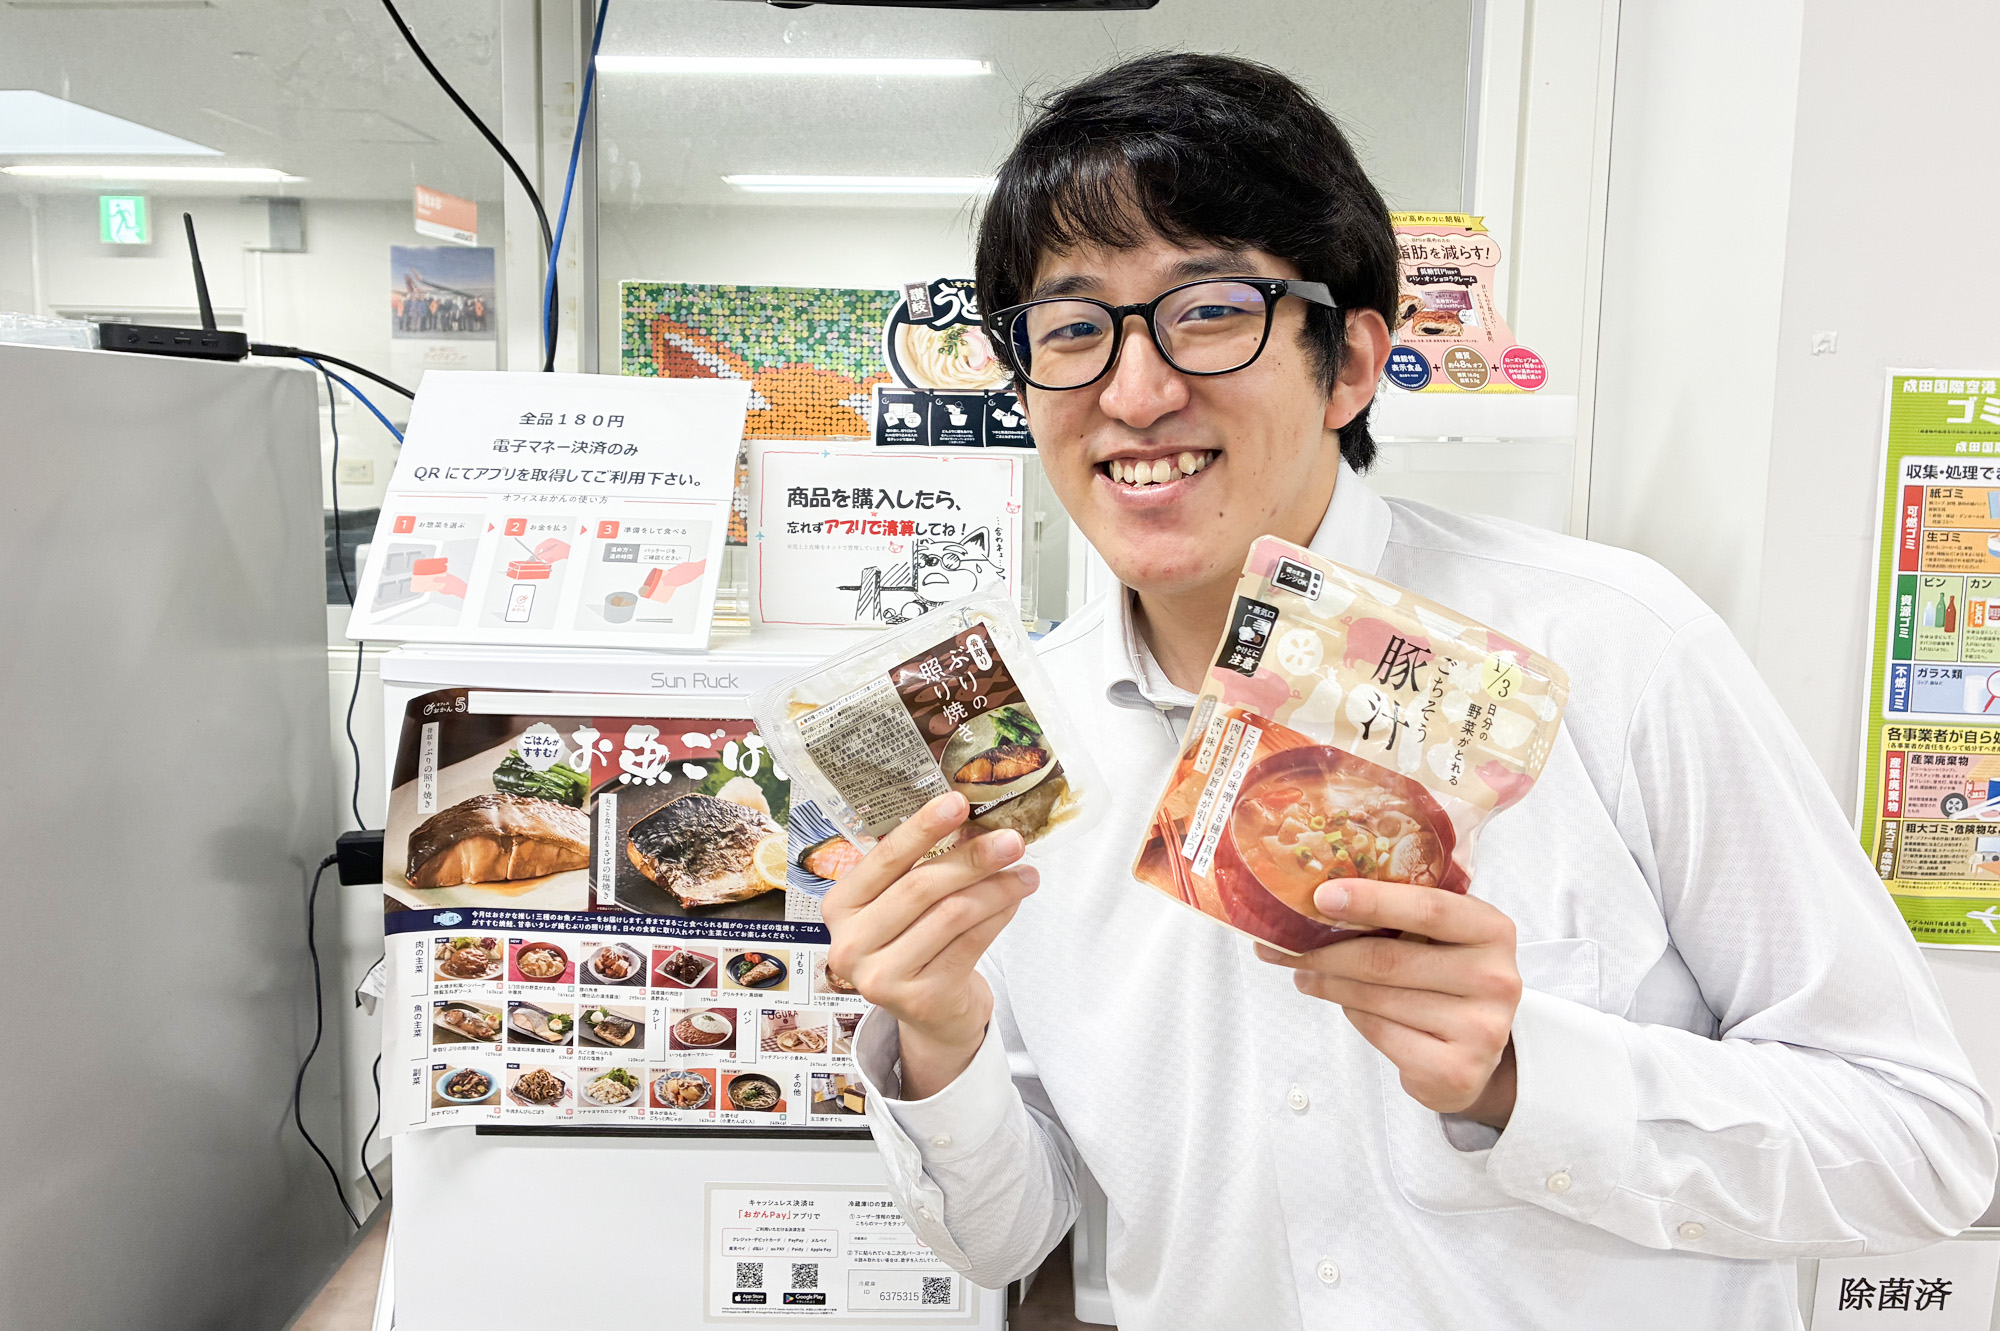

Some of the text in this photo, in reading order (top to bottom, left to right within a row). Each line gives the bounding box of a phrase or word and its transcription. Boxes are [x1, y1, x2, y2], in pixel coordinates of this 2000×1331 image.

[1903, 379, 1997, 394] 成田国際空港
[1946, 396, 2000, 426] ゴミ
[519, 412, 624, 428] 全品１８０円
[493, 438, 639, 456] 電子マネー決済のみ
[413, 467, 702, 487] QR にてアプリを取得してご利用下さい。
[502, 494, 608, 505] オフィスおかんの使い方
[787, 487, 961, 511] 商品を購入したら、
[1929, 488, 1964, 499] 紙ゴミ
[401, 519, 408, 529] 1
[418, 521, 466, 529] お惣菜を選ぶ
[511, 522, 520, 532] 2
[530, 523, 567, 532] お金を払う
[603, 525, 612, 534] 3
[623, 527, 687, 535] 準備をして食べる
[787, 519, 966, 537] 忘れずアプリで清算してね！
[1927, 532, 1961, 542] 生ゴミ
[1279, 571, 1308, 588] レンジOK
[1285, 566, 1305, 578] 袋のまま
[1924, 578, 1946, 587] ビン
[1970, 579, 1992, 589] カン
[1252, 606, 1275, 620] 蒸気口
[969, 638, 989, 666] 骨取り
[1234, 643, 1260, 659] やけどに
[1228, 652, 1255, 671] 注意
[650, 672, 739, 689] Sun Ruck
[949, 644, 988, 709] ぶりの
[1917, 668, 1963, 679] ガラス類
[920, 657, 974, 743] 照り焼き
[1364, 635, 1432, 750] 豚汁
[1418, 658, 1457, 742] ごちそう
[1479, 703, 1497, 741] 日分の
[523, 735, 559, 746] ごはんが
[1198, 716, 1225, 772] 深い味わい。
[1448, 704, 1482, 785] 野菜がとれる
[523, 749, 558, 758] すすむ！
[1911, 754, 1969, 766] 産業廃棄物
[422, 748, 433, 808] ぶりの照り焼き
[1887, 757, 1901, 812] 産業廃棄物
[1905, 824, 2000, 835] 粗大ゴミ・危険物な
[601, 849, 612, 900] さばの塩焼き
[414, 941, 424, 973] 肉の主菜
[795, 952, 804, 975] 汁もの
[413, 1004, 422, 1038] 魚の主菜
[652, 1008, 660, 1030] カレー
[743, 1010, 752, 1024] パン
[412, 1068, 422, 1085] 副菜
[793, 1074, 802, 1096] その他
[738, 1209, 821, 1220] 「おかんPay」アプリで
[879, 1292, 920, 1301] 6375315
[1838, 1277, 1952, 1311] 除菌済
